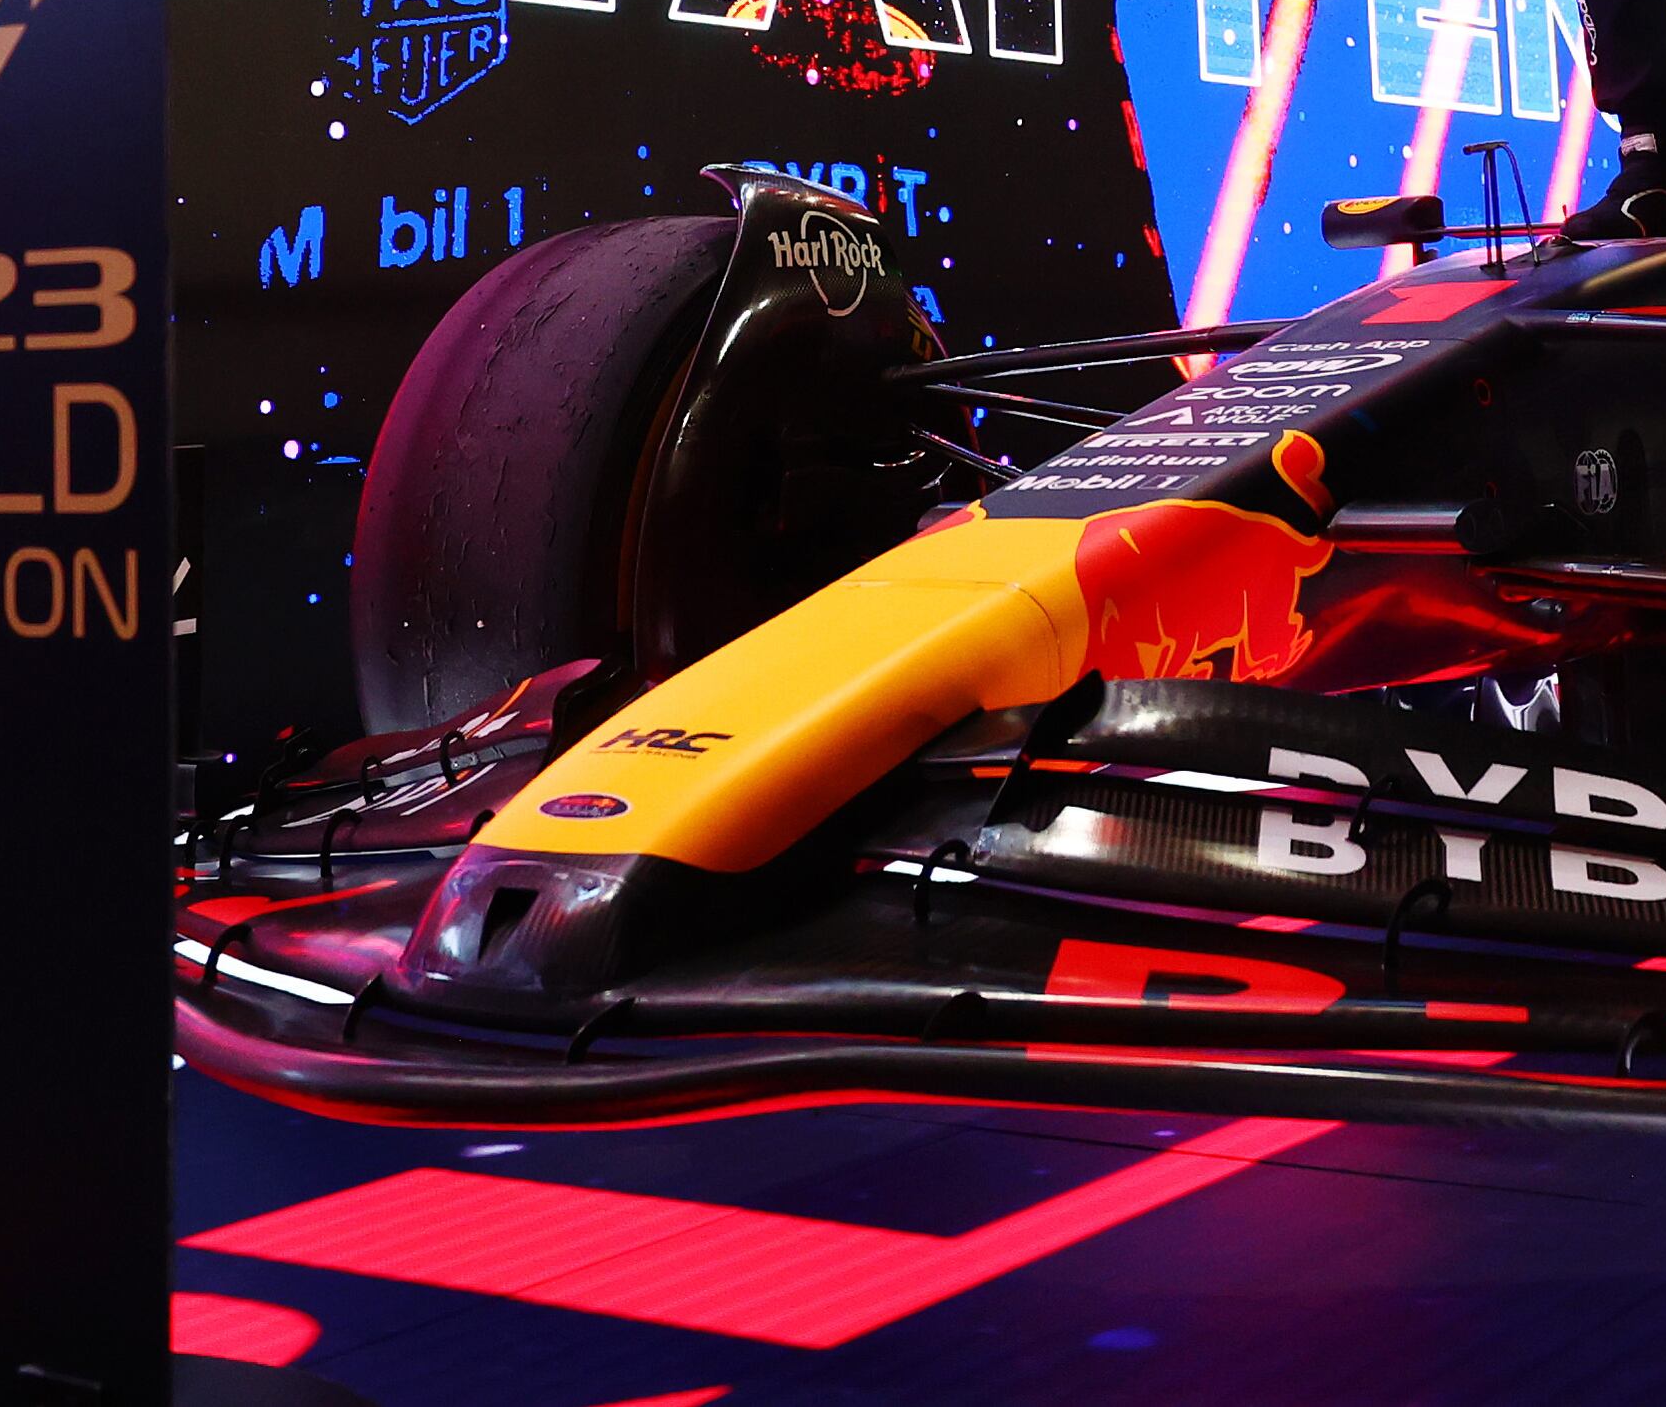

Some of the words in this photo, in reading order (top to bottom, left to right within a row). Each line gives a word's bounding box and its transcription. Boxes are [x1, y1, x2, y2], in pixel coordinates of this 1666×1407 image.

[829, 230, 886, 277] Rock
[1268, 341, 1360, 354] Cash
[1363, 338, 1431, 352] App
[1227, 357, 1369, 377] CDW
[1174, 382, 1353, 402] zoom
[1201, 403, 1317, 416] ARCTIC
[1200, 412, 1297, 426] WOLF
[1082, 431, 1271, 449] PIRELLI
[1045, 453, 1228, 467] infinitum
[1003, 474, 1141, 492] Mobil
